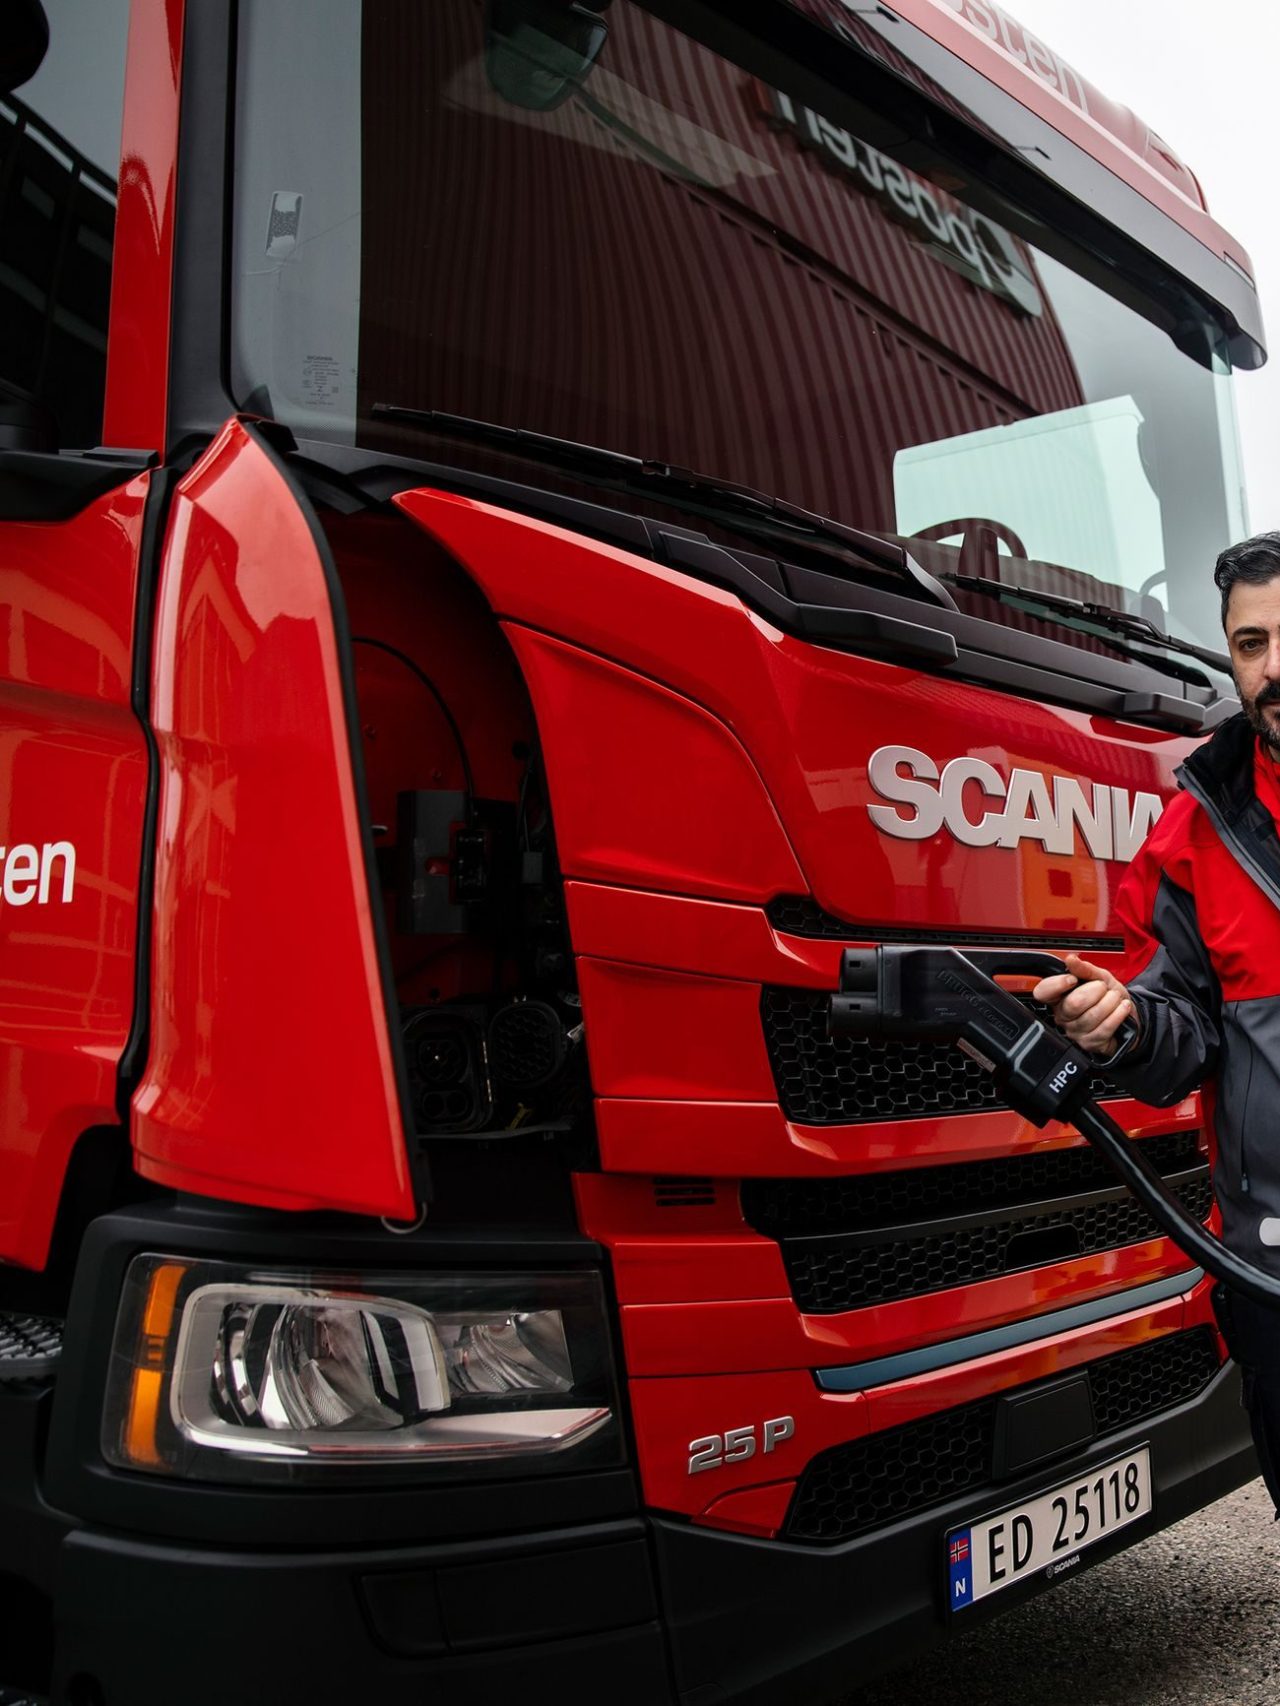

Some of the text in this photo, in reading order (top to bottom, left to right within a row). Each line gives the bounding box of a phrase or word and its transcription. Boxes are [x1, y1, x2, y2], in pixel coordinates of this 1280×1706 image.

[0, 841, 76, 907] en
[1049, 1061, 1078, 1093] HPC
[688, 1415, 795, 1474] 25 P
[988, 1462, 1140, 1584] ED 25118
[1054, 1555, 1080, 1574] SCANIA
[955, 1578, 966, 1597] N
